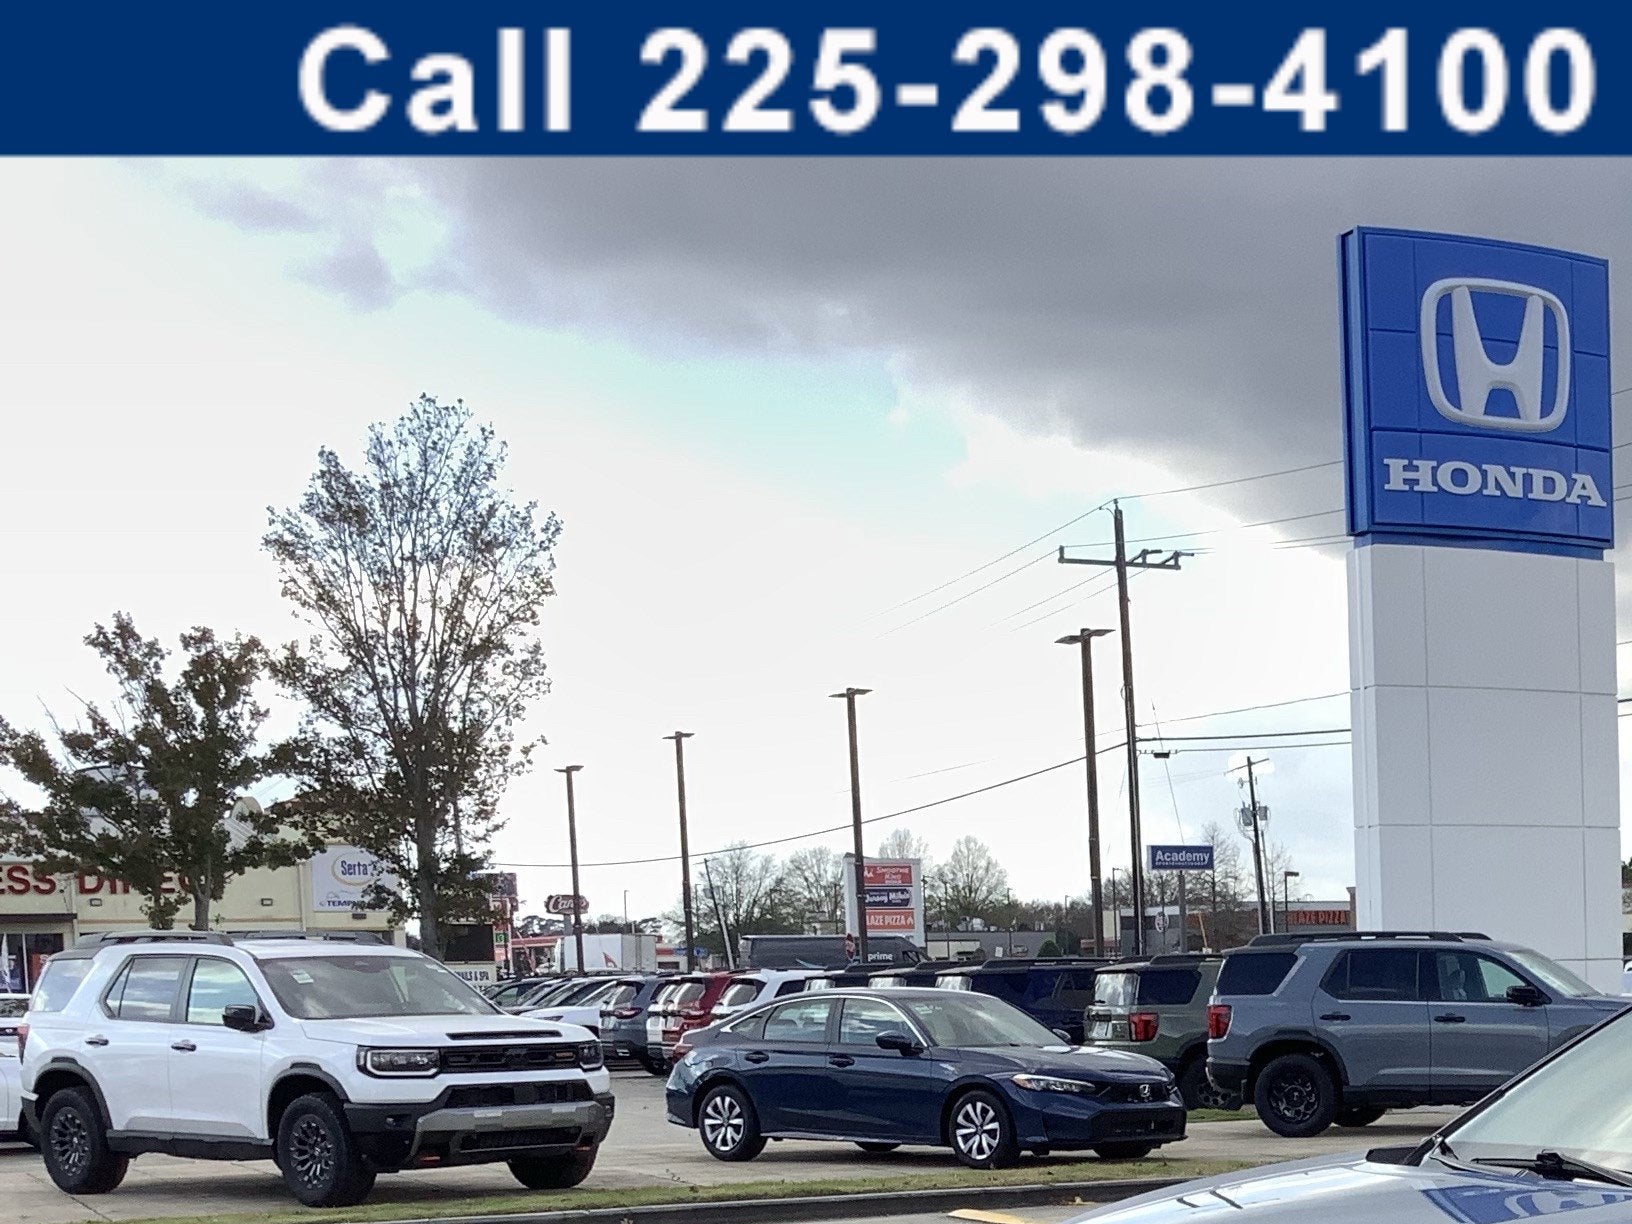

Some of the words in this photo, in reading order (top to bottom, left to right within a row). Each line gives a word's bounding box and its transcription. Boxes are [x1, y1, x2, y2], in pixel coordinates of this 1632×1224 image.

[1384, 457, 1608, 508] HONDA
[1155, 850, 1210, 864] Academy
[341, 860, 368, 876] Serta
[865, 915, 885, 926] LAZE
[885, 915, 906, 926] PIZZA
[868, 952, 893, 961] prime
